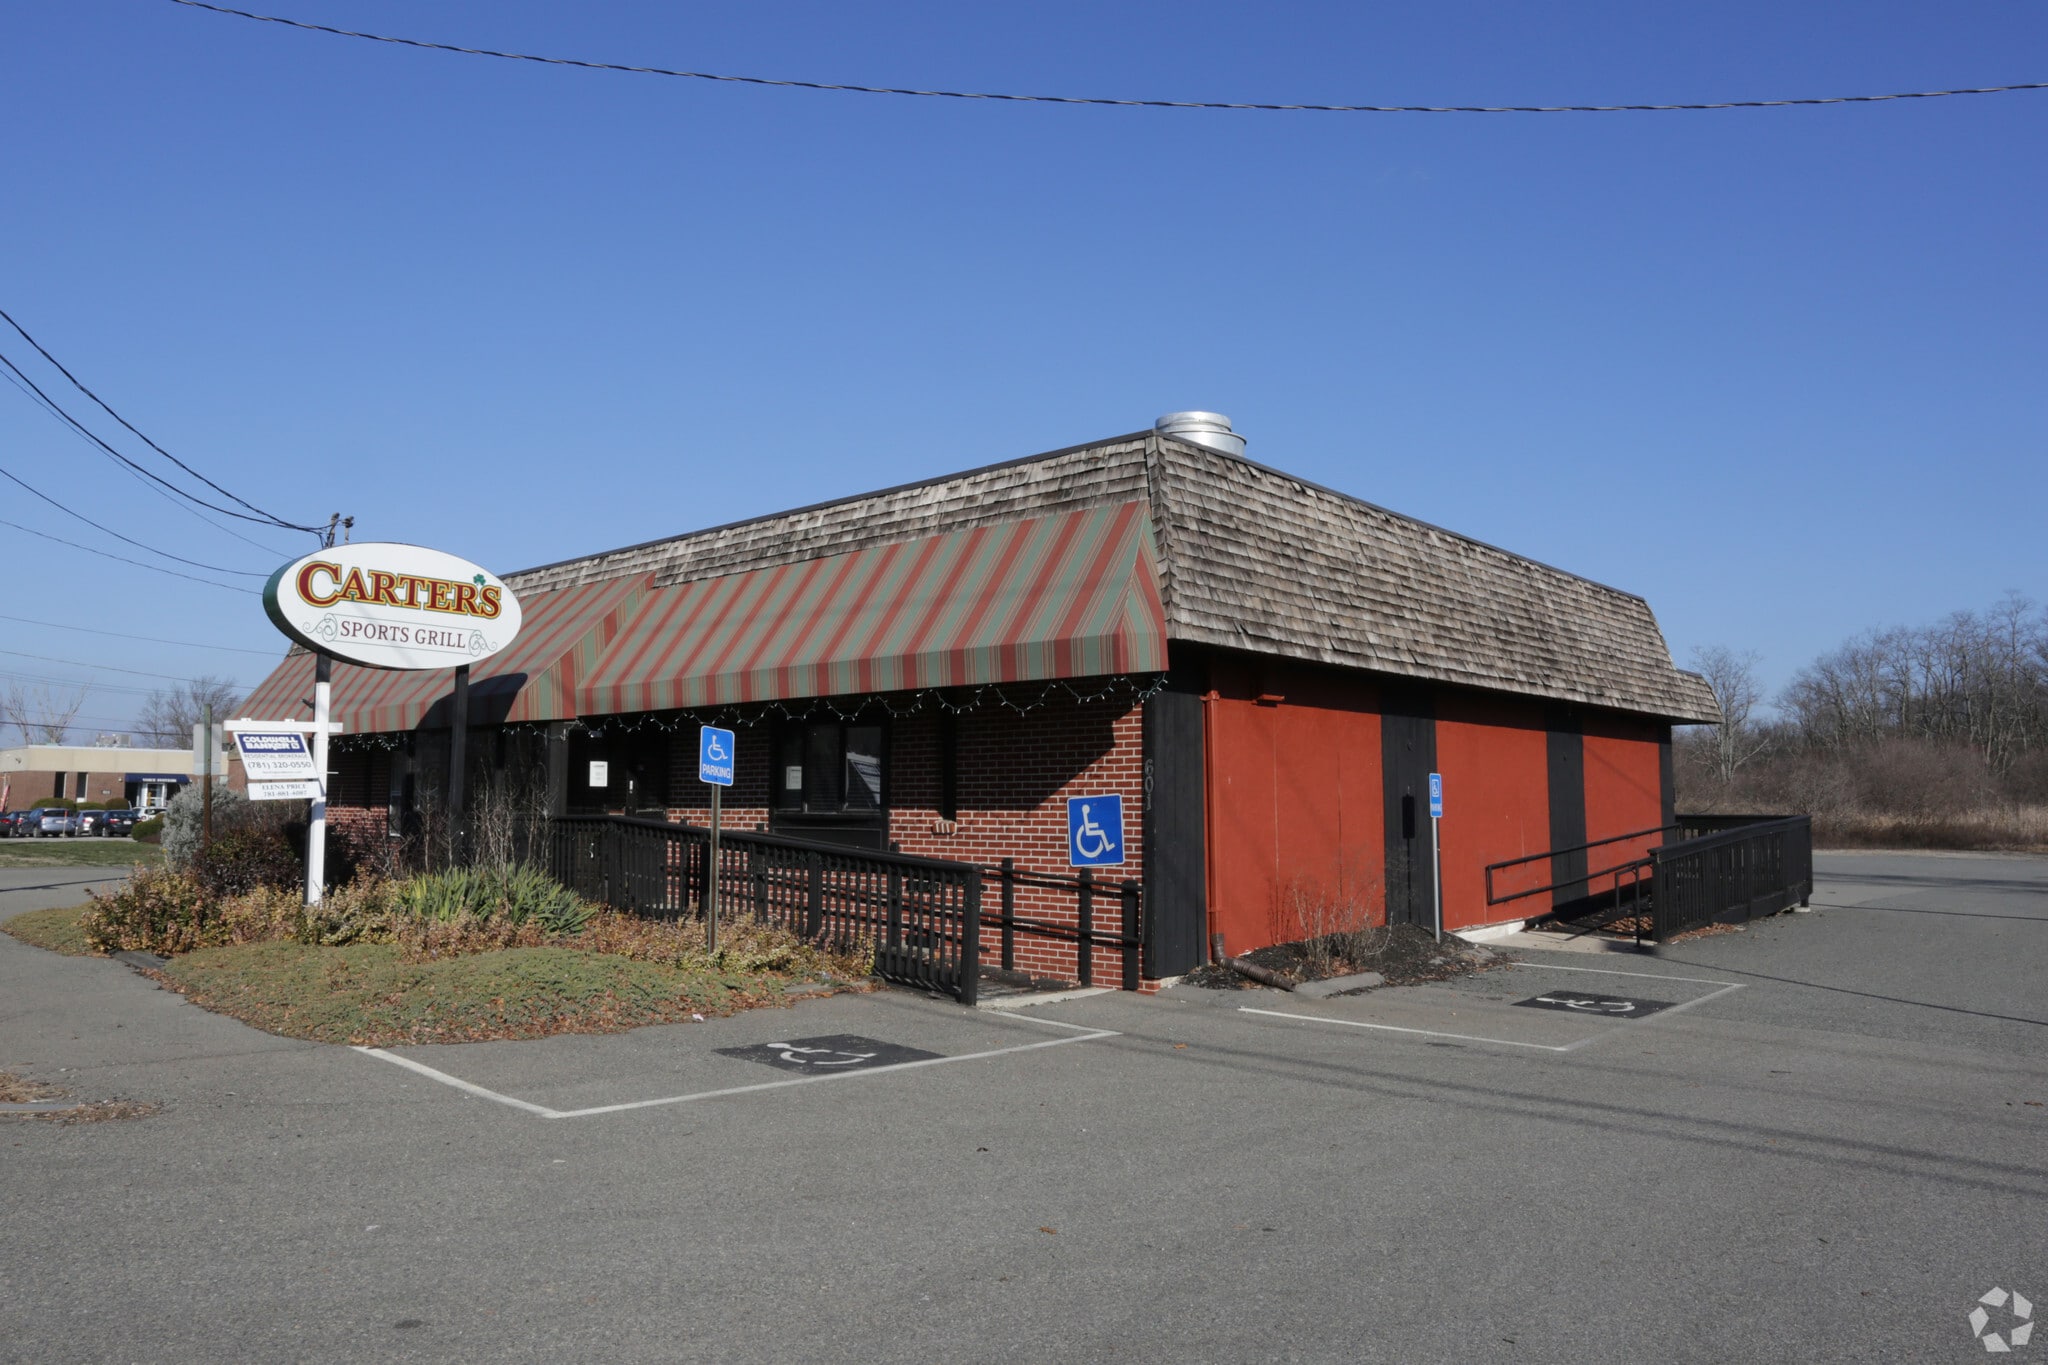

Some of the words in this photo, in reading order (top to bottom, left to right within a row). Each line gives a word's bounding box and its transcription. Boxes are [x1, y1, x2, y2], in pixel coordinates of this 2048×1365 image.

[340, 620, 410, 643] SPORTS
[414, 630, 466, 649] GRILL
[247, 761, 271, 769] (781)
[702, 763, 731, 779] PARKING
